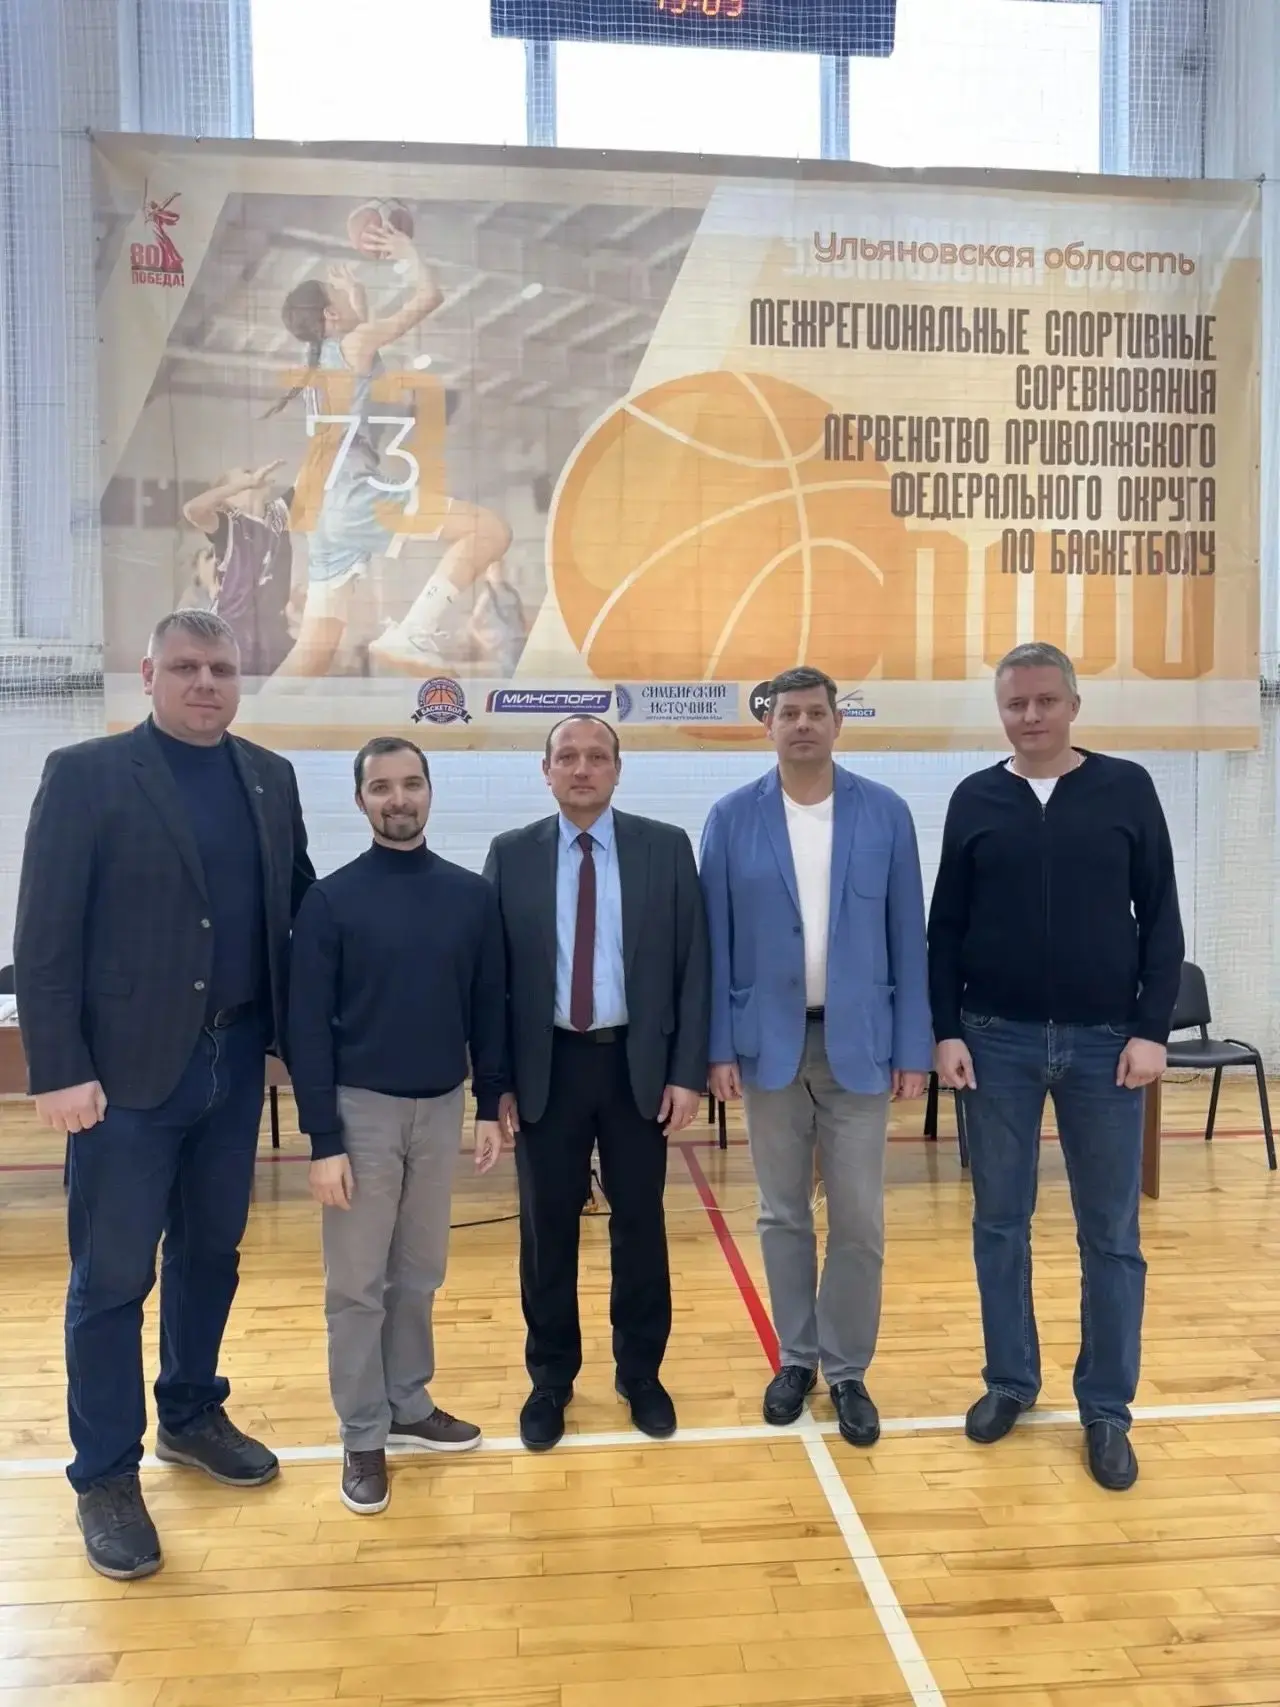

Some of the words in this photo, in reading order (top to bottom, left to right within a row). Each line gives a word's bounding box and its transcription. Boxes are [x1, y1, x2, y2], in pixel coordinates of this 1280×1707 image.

[130, 243, 160, 268] 80
[813, 231, 1034, 268] Ульяновская
[1044, 241, 1196, 276] область
[131, 271, 185, 288] ПОБЕДА!
[750, 298, 1030, 356] МЕЖРЕГИОНАЛЬНЫЕ
[1045, 309, 1217, 361] СПОРТИВНЫЕ
[1015, 363, 1217, 415] СОРЕВНОВАНИЯ
[306, 415, 419, 492] 73
[824, 413, 990, 464] ПЕРВЕНСТВО
[1004, 419, 1217, 469] ПРИВОЛЖСКОГО
[890, 471, 1102, 522] ФЕДЕРАЛЬНОГО
[1117, 475, 1217, 523] ОКРУГА
[1001, 528, 1035, 575] ПО
[1050, 528, 1217, 577] БАСКЕТБОЛУ
[420, 704, 463, 714] БАСКЕТБОЛ
[501, 693, 607, 705] МИНСПОРТ
[641, 685, 726, 698] СИМБИРСКИЙ
[650, 701, 718, 714] ИСТОЧНИК
